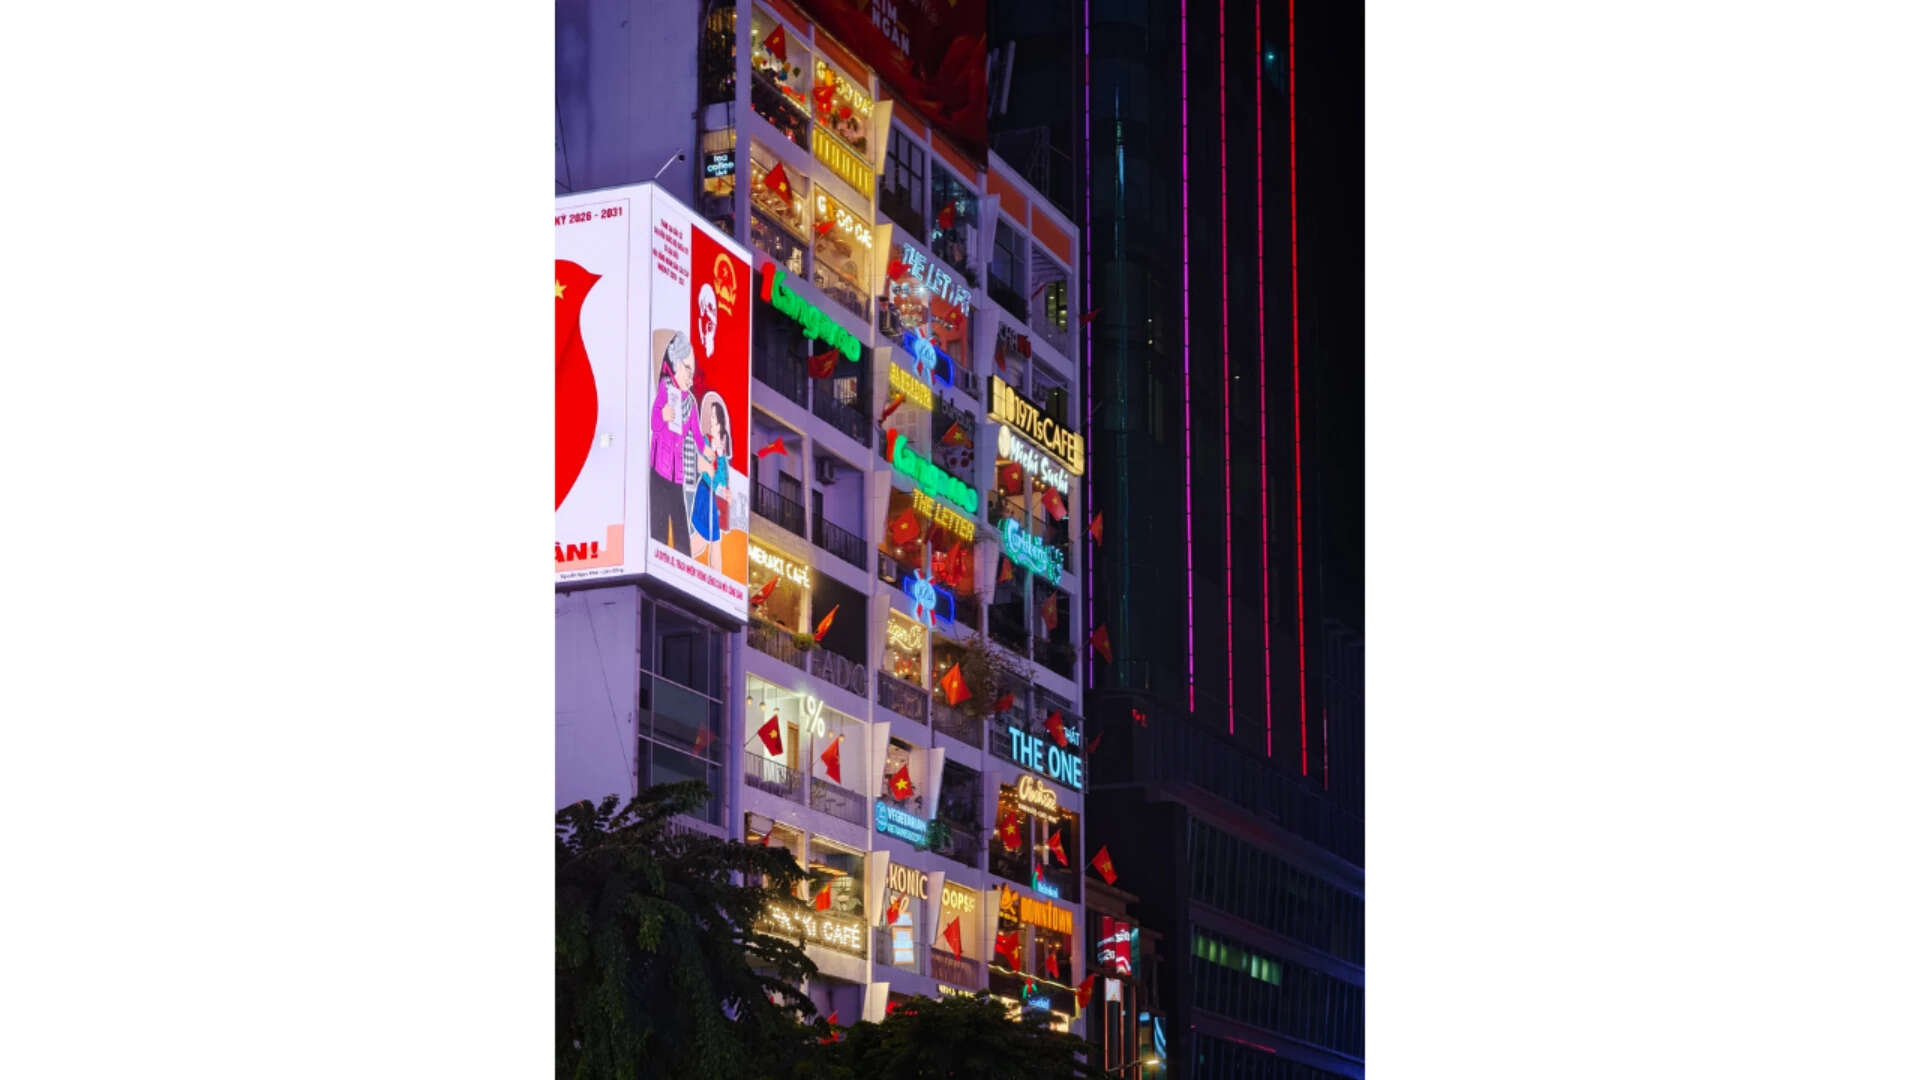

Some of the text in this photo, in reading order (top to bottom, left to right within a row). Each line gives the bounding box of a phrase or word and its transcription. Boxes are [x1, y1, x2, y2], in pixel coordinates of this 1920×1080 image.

[569, 210, 592, 224] 2026
[913, 487, 975, 542] THE LETTER
[1009, 726, 1083, 789] THE ONE
